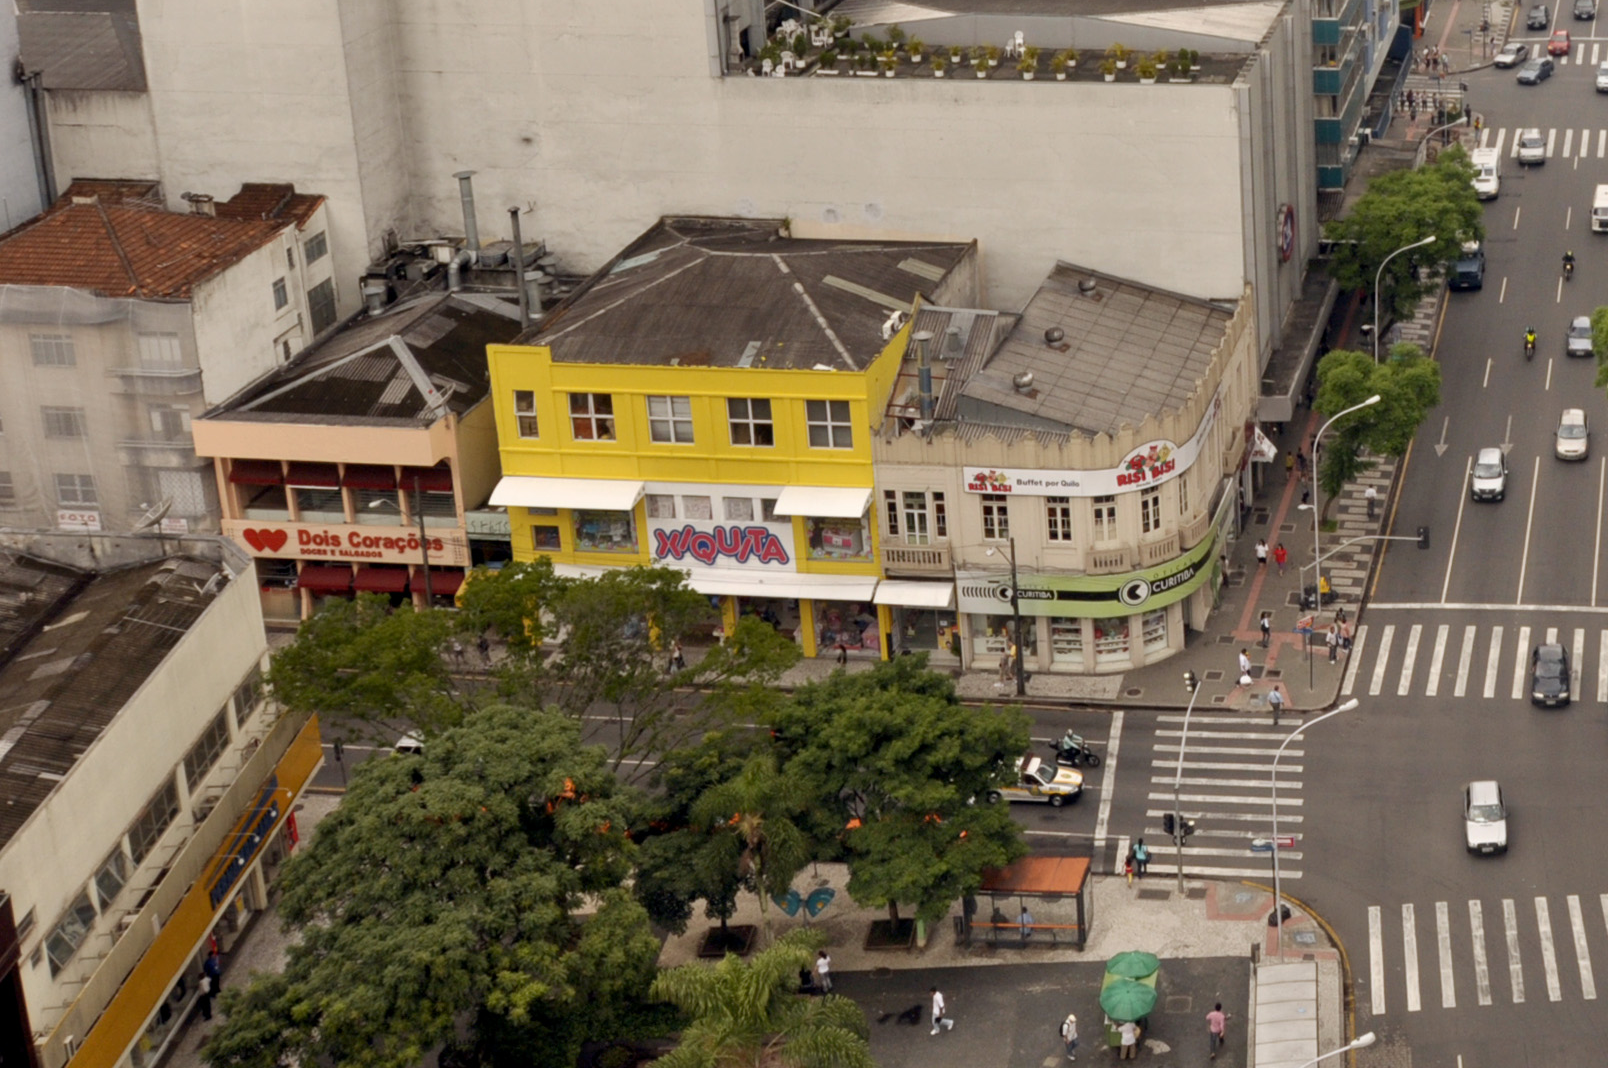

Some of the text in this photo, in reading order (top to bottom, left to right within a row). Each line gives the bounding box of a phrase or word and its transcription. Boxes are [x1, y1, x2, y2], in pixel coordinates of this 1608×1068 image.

[1016, 478, 1042, 486] Buffet
[1116, 457, 1175, 487] RISI BISI
[297, 530, 444, 554] Dois Corações
[300, 548, 328, 556] DOCES
[339, 549, 383, 558] SALGADOS
[655, 524, 790, 566] XIQUITA
[1152, 567, 1195, 592] CURITIBA
[1017, 590, 1052, 599] CURITIBA
